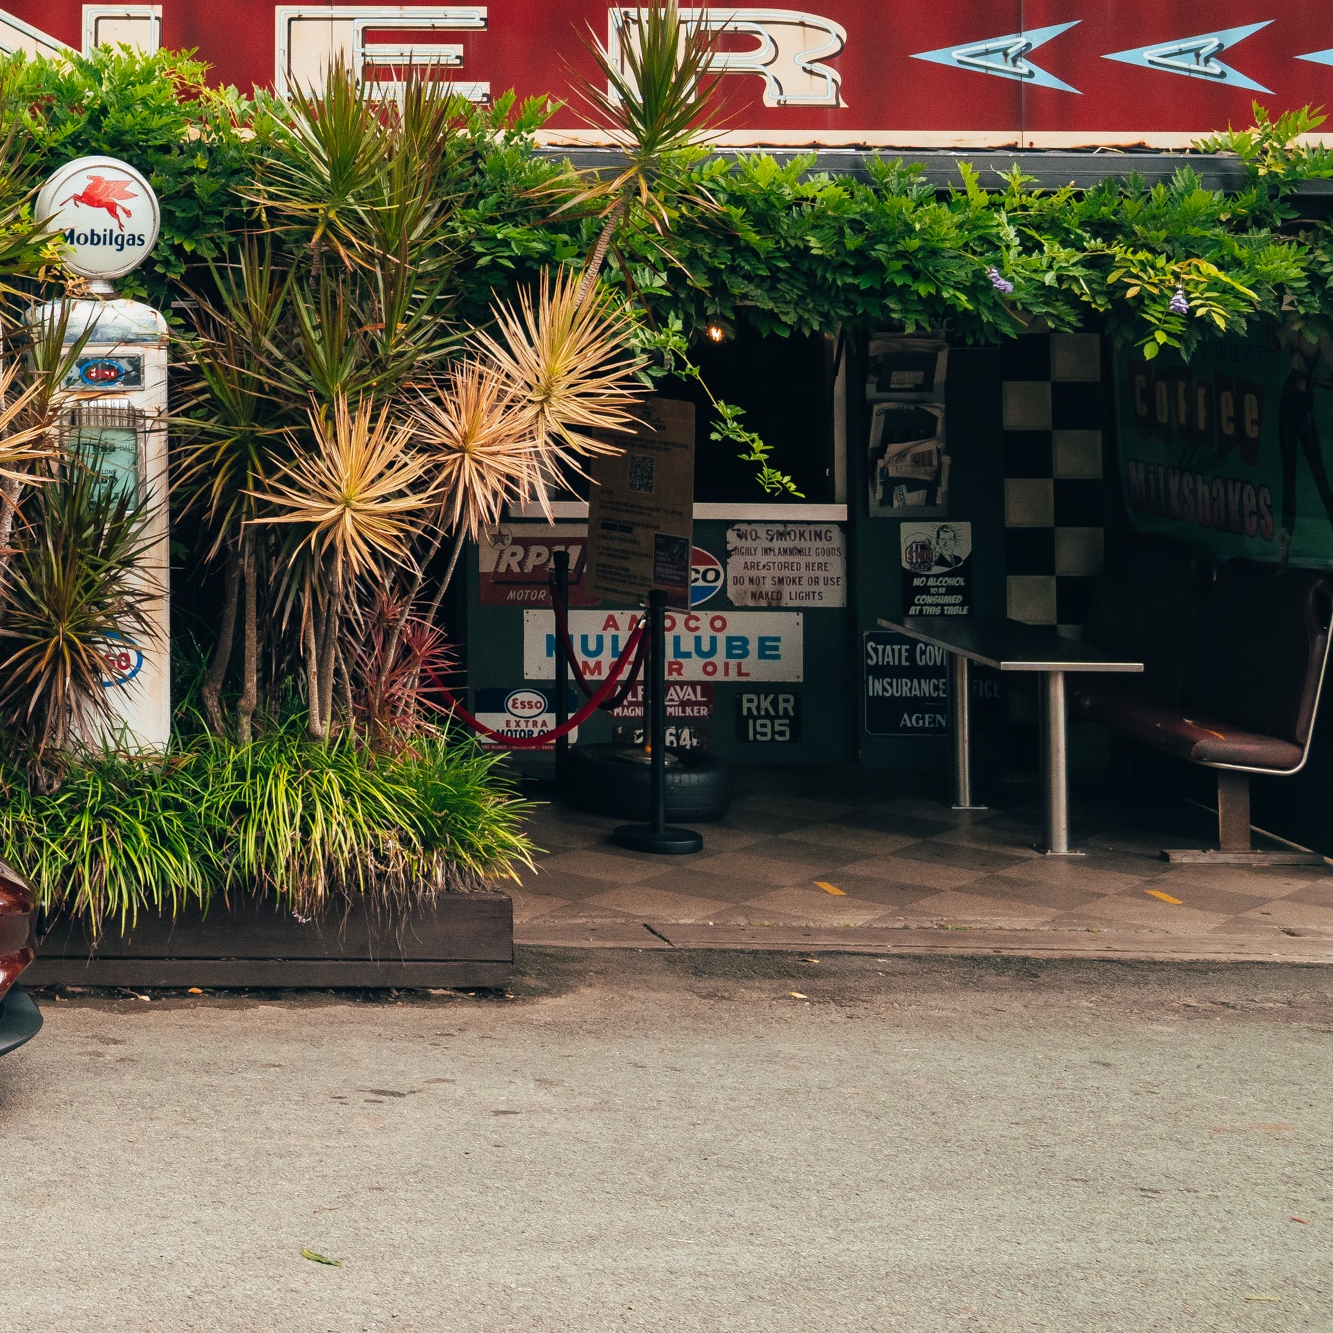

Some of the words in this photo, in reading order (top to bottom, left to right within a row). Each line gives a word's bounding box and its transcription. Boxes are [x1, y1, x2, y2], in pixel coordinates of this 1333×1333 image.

[59, 229, 145, 252] Mobilgas
[737, 529, 760, 542] NO
[766, 529, 833, 542] SMOKING
[761, 547, 812, 557] INFLAMMABLE
[815, 547, 842, 557] GOODS
[743, 561, 761, 572] ARE
[766, 561, 802, 572] STORED
[805, 561, 829, 572] HERE
[733, 576, 744, 586] DO
[748, 576, 766, 586] NOT
[771, 576, 803, 586] SMOKE
[807, 576, 819, 586] OR
[823, 576, 841, 586] USE
[913, 577, 925, 587] NO
[927, 577, 965, 587] ALCOHOL
[506, 589, 547, 600] MOTOR
[750, 591, 782, 601] NAKED
[789, 591, 823, 601] LIGHTS
[914, 595, 962, 604] CONSUMED
[909, 606, 921, 616] AT
[923, 606, 941, 616] THIS
[943, 606, 969, 616] TABLE
[546, 634, 782, 660] ULLUBE
[866, 641, 910, 666] STATE
[583, 660, 683, 677] MOR
[702, 660, 750, 678] OIL
[868, 676, 947, 697] INSURANCE
[615, 685, 644, 705] ALF
[664, 685, 708, 705] AVAL
[511, 697, 543, 710] Esso
[742, 694, 795, 716] RKR
[614, 707, 644, 717] MAGN
[666, 707, 708, 717] MILKER
[506, 720, 548, 728] EXTRA
[900, 712, 947, 728] AGEN
[496, 729, 534, 738] MOTOR
[748, 719, 790, 742] 195
